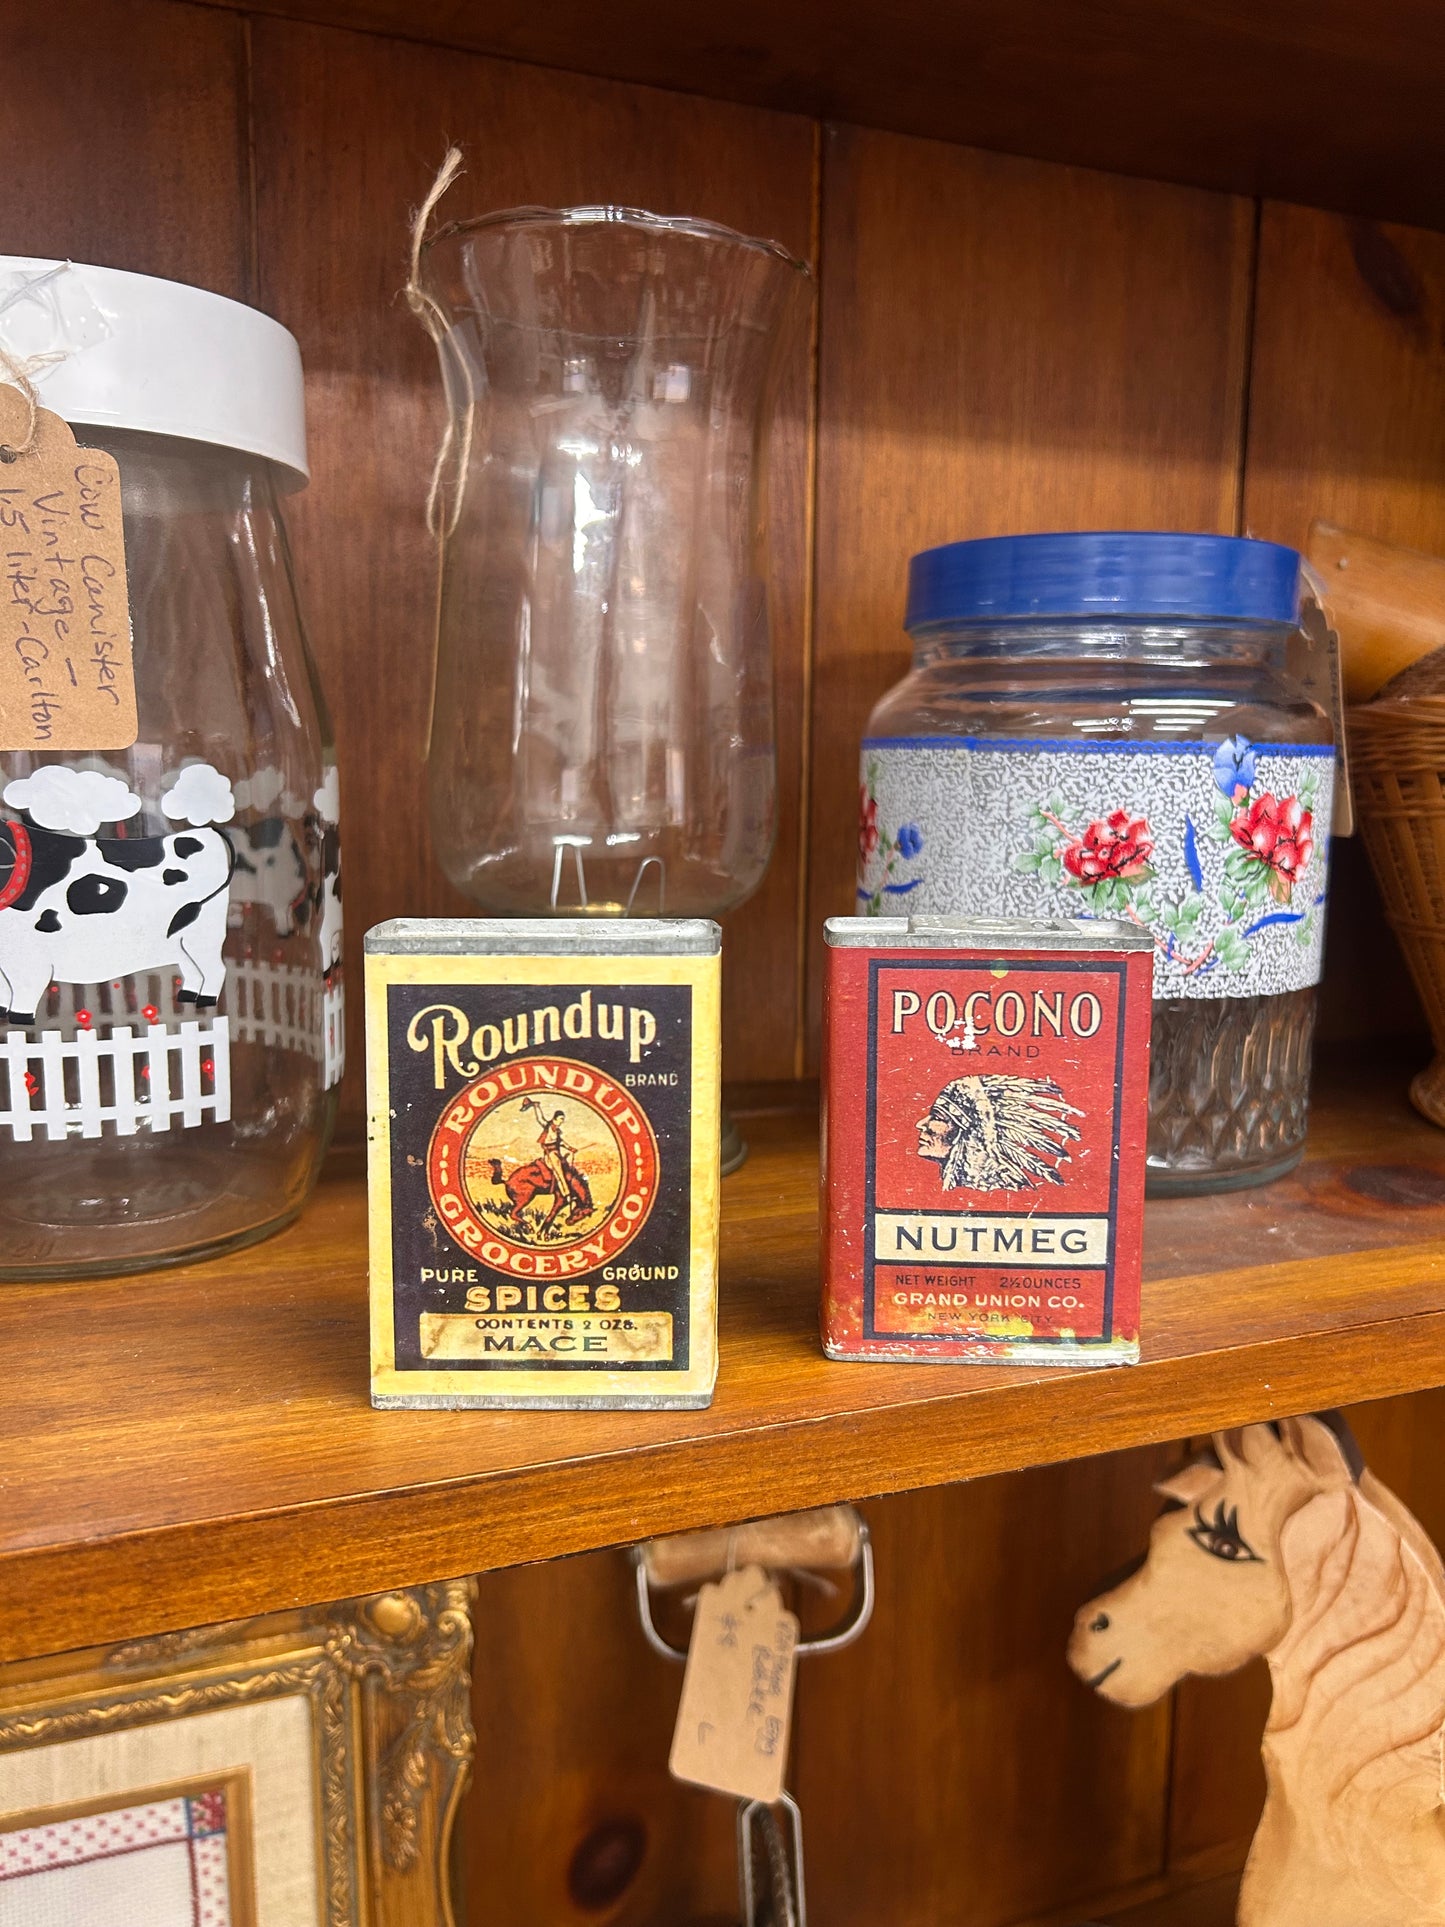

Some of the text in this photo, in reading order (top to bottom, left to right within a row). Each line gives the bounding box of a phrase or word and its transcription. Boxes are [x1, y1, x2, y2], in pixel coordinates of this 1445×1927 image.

[33, 490, 75, 641] Vintage
[74, 464, 123, 706] Cow Canister
[891, 990, 1103, 1038] POCONO
[407, 991, 656, 1089] Roundup
[951, 1045, 1040, 1058] BRAND
[625, 1073, 679, 1087] BRAND
[445, 1064, 641, 1135] ROUNDUP
[440, 1186, 648, 1275] GROCERY CO.
[895, 1226, 1088, 1254] NUTMEG
[421, 1266, 679, 1282] PURE GROUND
[895, 1275, 921, 1286] NET
[924, 1276, 976, 1287] WEIGHT
[465, 1286, 621, 1311] SPICES
[893, 1292, 1085, 1309] GRAND UNION CO.
[475, 1319, 573, 1330] CONTENTS
[583, 1319, 591, 1330] 2
[928, 1312, 962, 1322] NEW
[969, 1312, 1010, 1323] YORK
[484, 1336, 608, 1352] MACE
